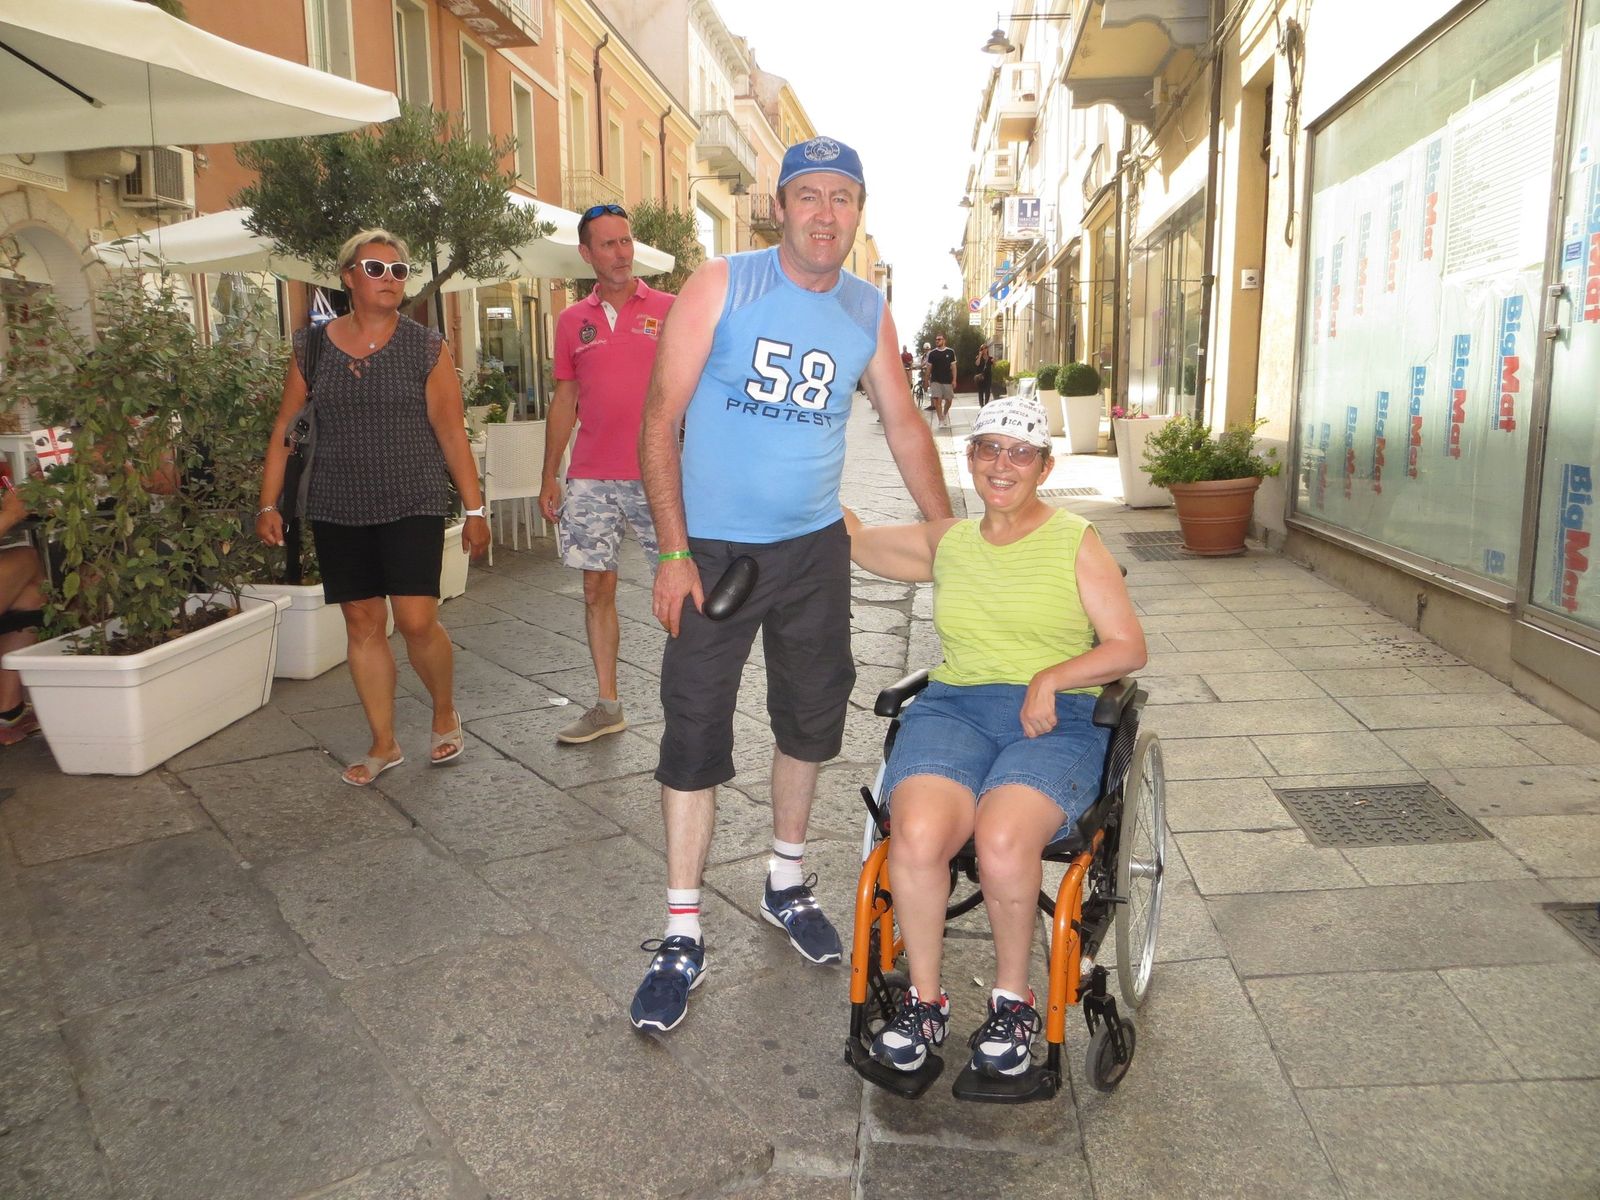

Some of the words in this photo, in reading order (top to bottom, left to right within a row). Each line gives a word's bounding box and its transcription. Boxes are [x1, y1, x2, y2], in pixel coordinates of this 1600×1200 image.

[726, 398, 832, 428] PROTEST
[744, 337, 836, 410] 58
[1450, 334, 1471, 460] BigMat
[1499, 295, 1523, 432] BigMat
[1372, 391, 1389, 496] BigMat
[1408, 366, 1426, 480] BigMat
[1561, 464, 1593, 613] BigMat
